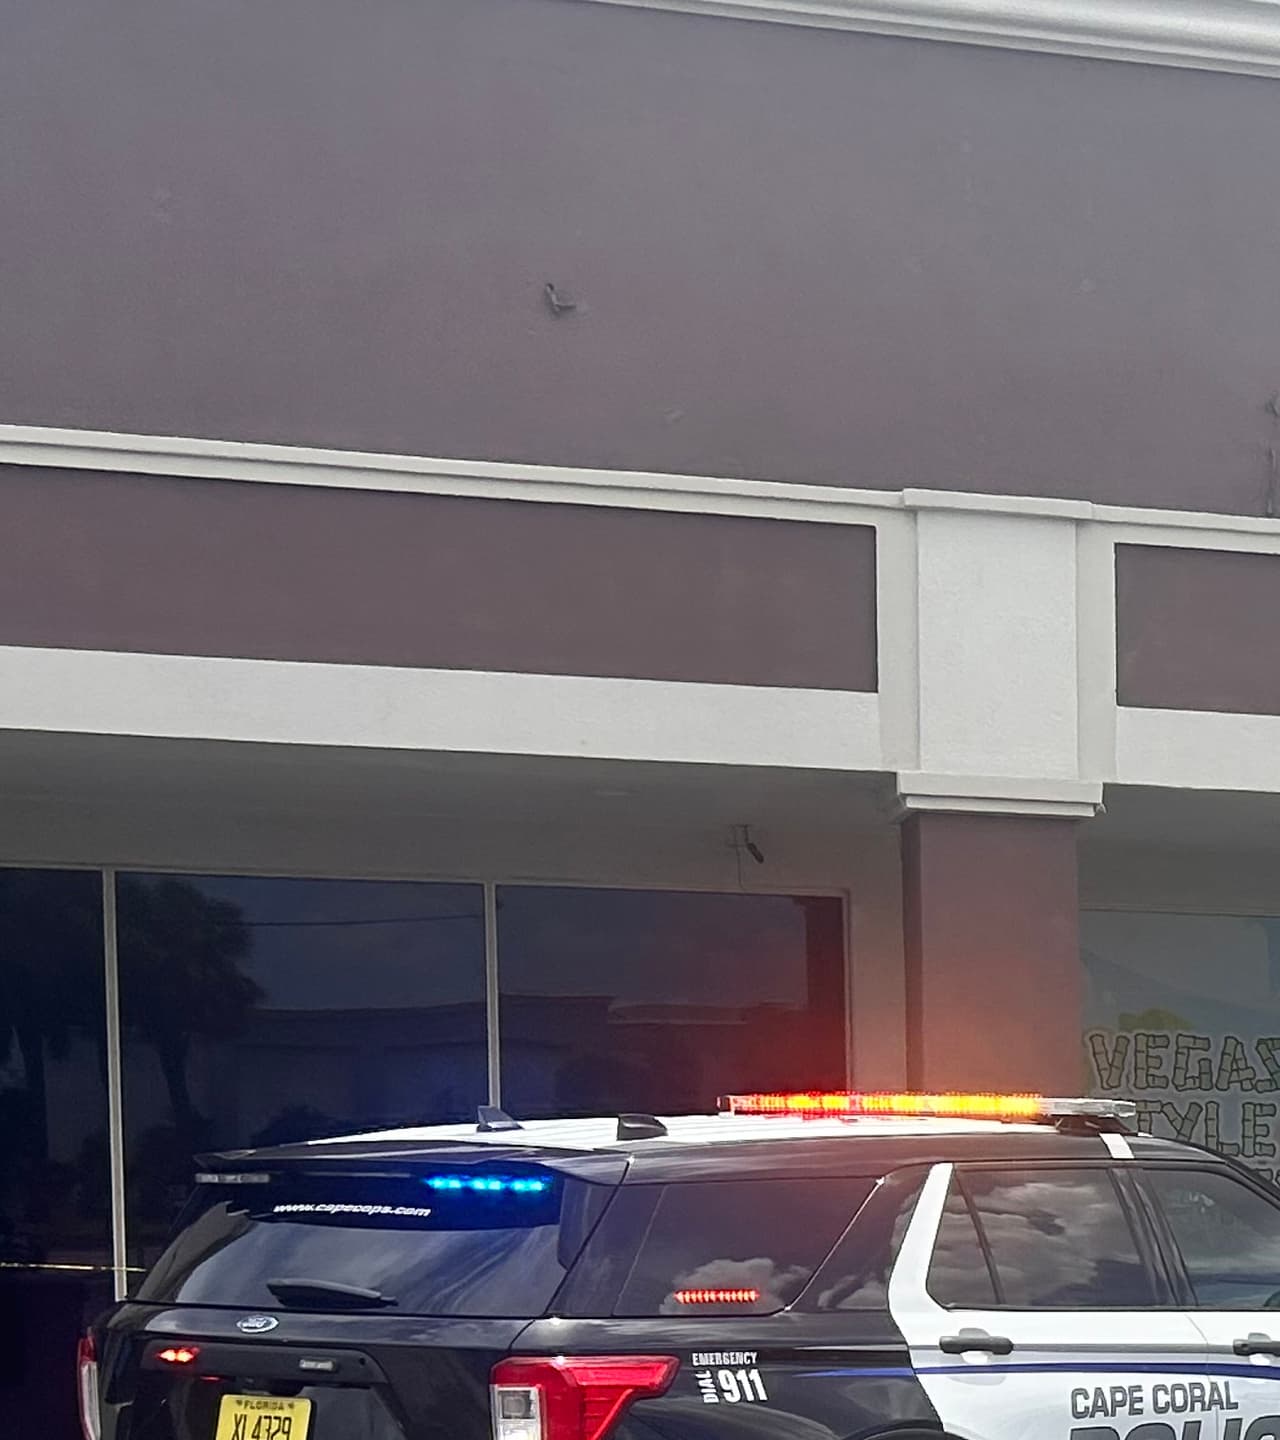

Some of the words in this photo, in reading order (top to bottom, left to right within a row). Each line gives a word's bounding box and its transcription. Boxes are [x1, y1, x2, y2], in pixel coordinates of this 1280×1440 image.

[1136, 1100, 1277, 1157] TYLE
[273, 1203, 431, 1217] www.capecops.com
[692, 1352, 758, 1366] EMERGENCY
[695, 1369, 719, 1403] DIAL
[718, 1369, 768, 1403] 911
[1071, 1385, 1144, 1419] CAPE
[1152, 1381, 1239, 1415] CORAL
[243, 1400, 285, 1410] FLORIDA
